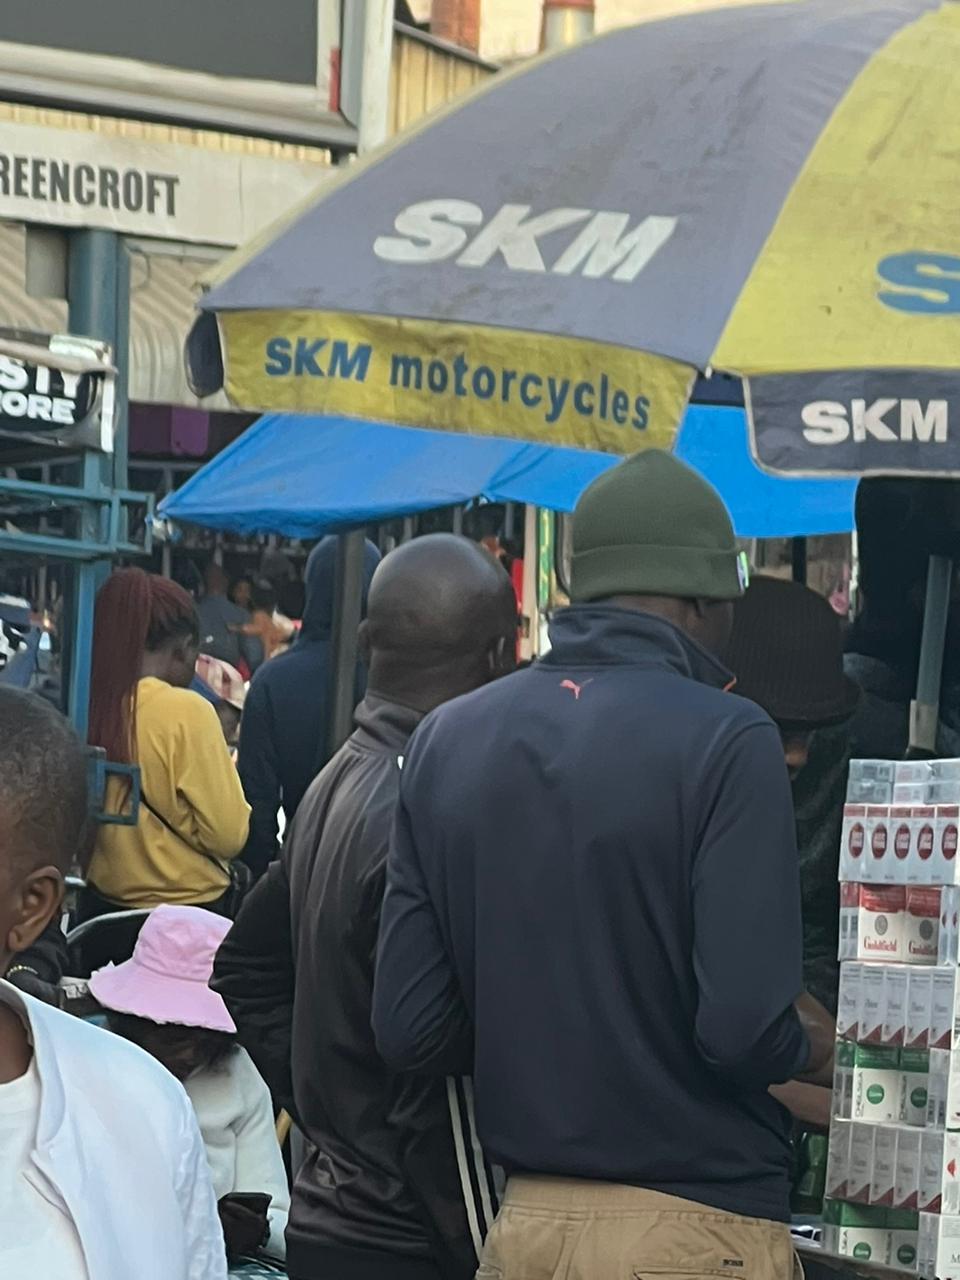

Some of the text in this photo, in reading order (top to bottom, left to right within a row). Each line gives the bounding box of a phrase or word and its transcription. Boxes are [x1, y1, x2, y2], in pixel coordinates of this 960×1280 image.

[372, 198, 680, 284] SKM
[0, 389, 76, 425] ORE
[264, 336, 652, 432] SKM motorcycles
[800, 398, 949, 446] SKM
